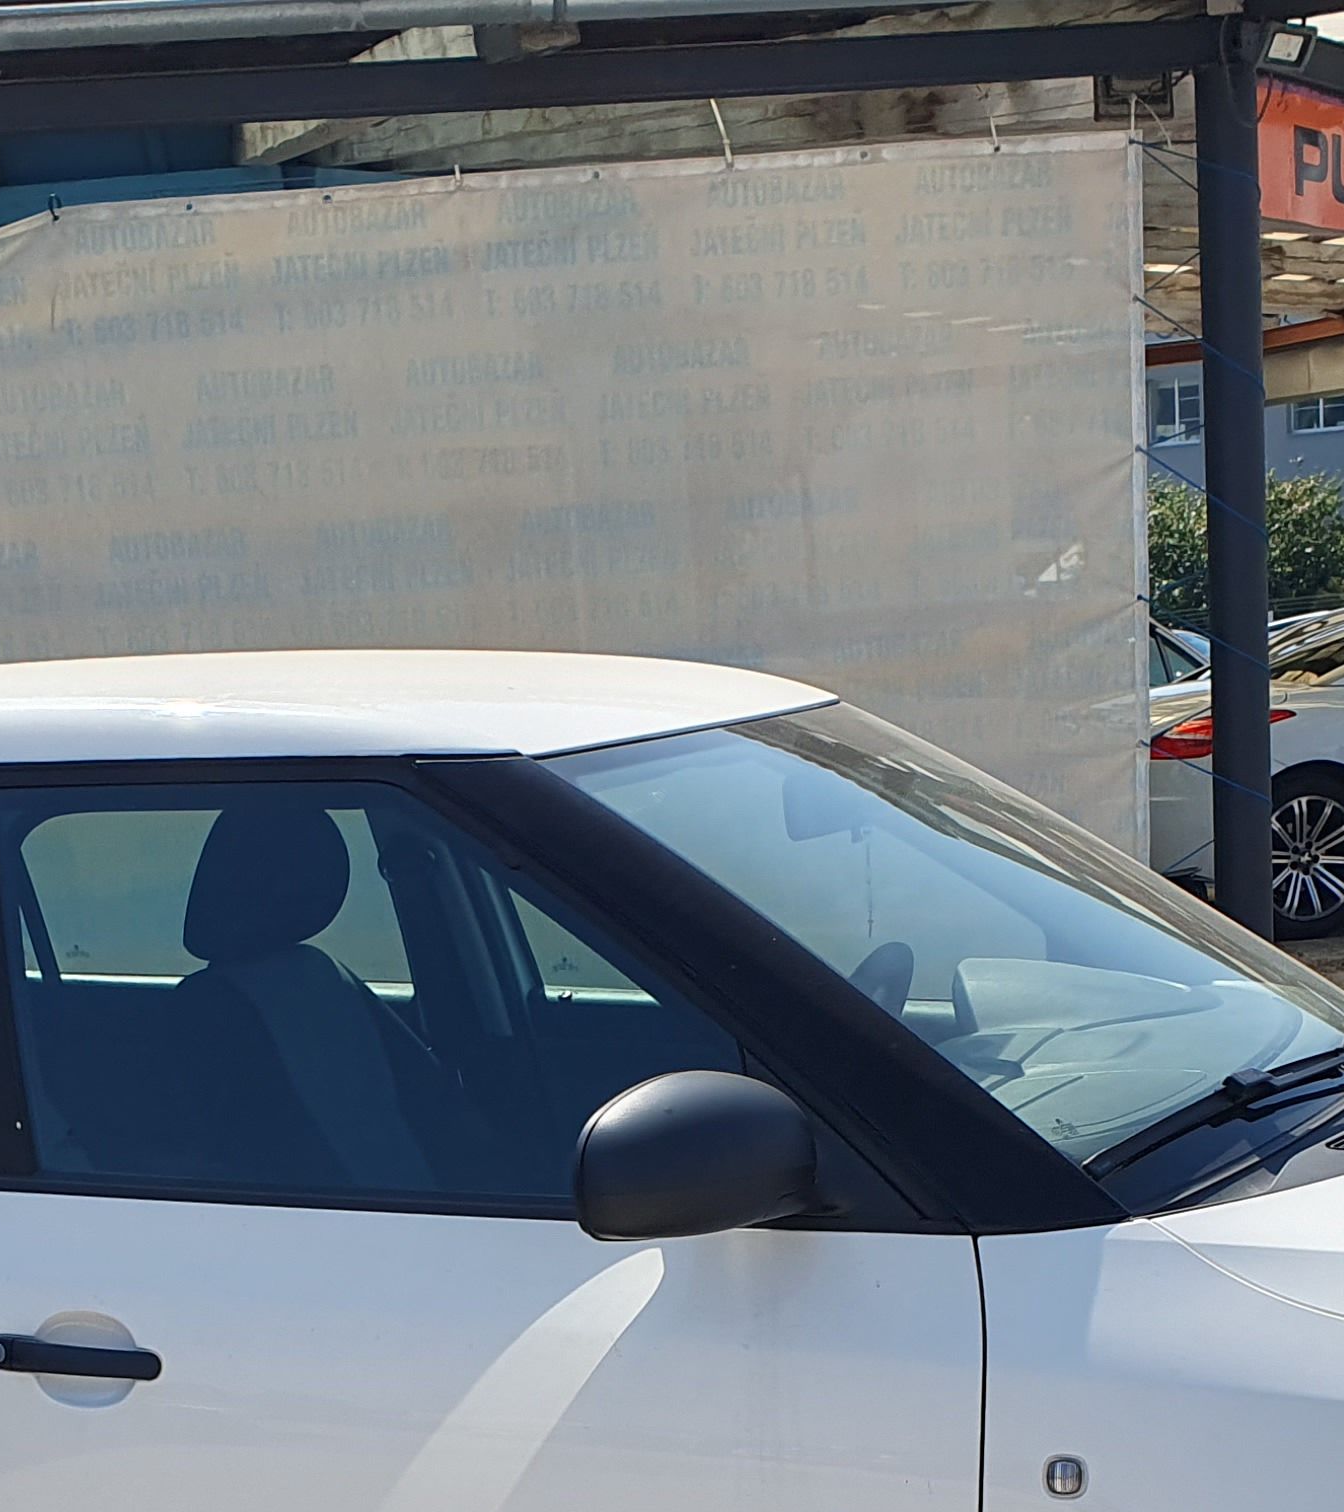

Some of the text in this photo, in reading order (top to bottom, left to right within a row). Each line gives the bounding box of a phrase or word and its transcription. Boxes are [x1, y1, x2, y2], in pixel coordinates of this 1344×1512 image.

[499, 185, 640, 224] AUTOBAZAR
[706, 172, 846, 209] AUTOBAZAR
[73, 217, 216, 255] AUTOBAZAR
[287, 200, 428, 239] AUTOBAZAR
